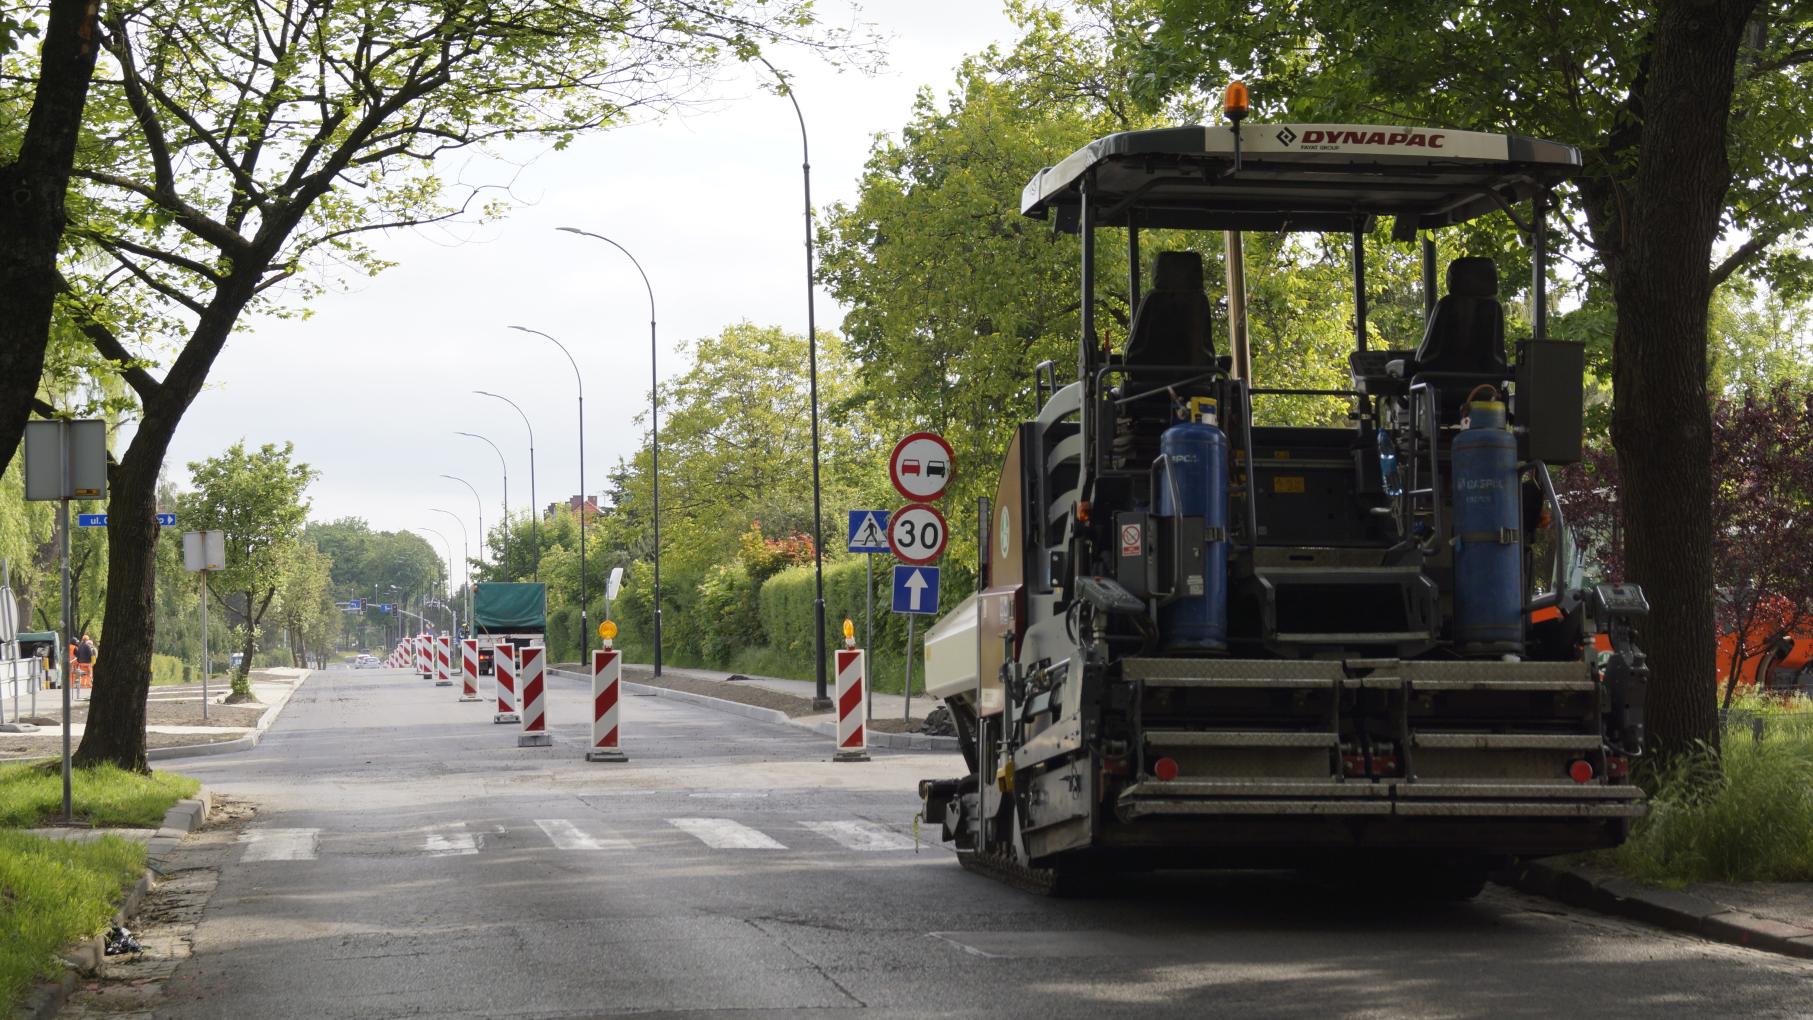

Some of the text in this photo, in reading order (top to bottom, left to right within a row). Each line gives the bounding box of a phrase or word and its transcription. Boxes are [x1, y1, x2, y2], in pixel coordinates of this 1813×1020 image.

[1301, 130, 1446, 148] DYNAPAC
[90, 516, 102, 525] ul.
[897, 519, 939, 550] 30
